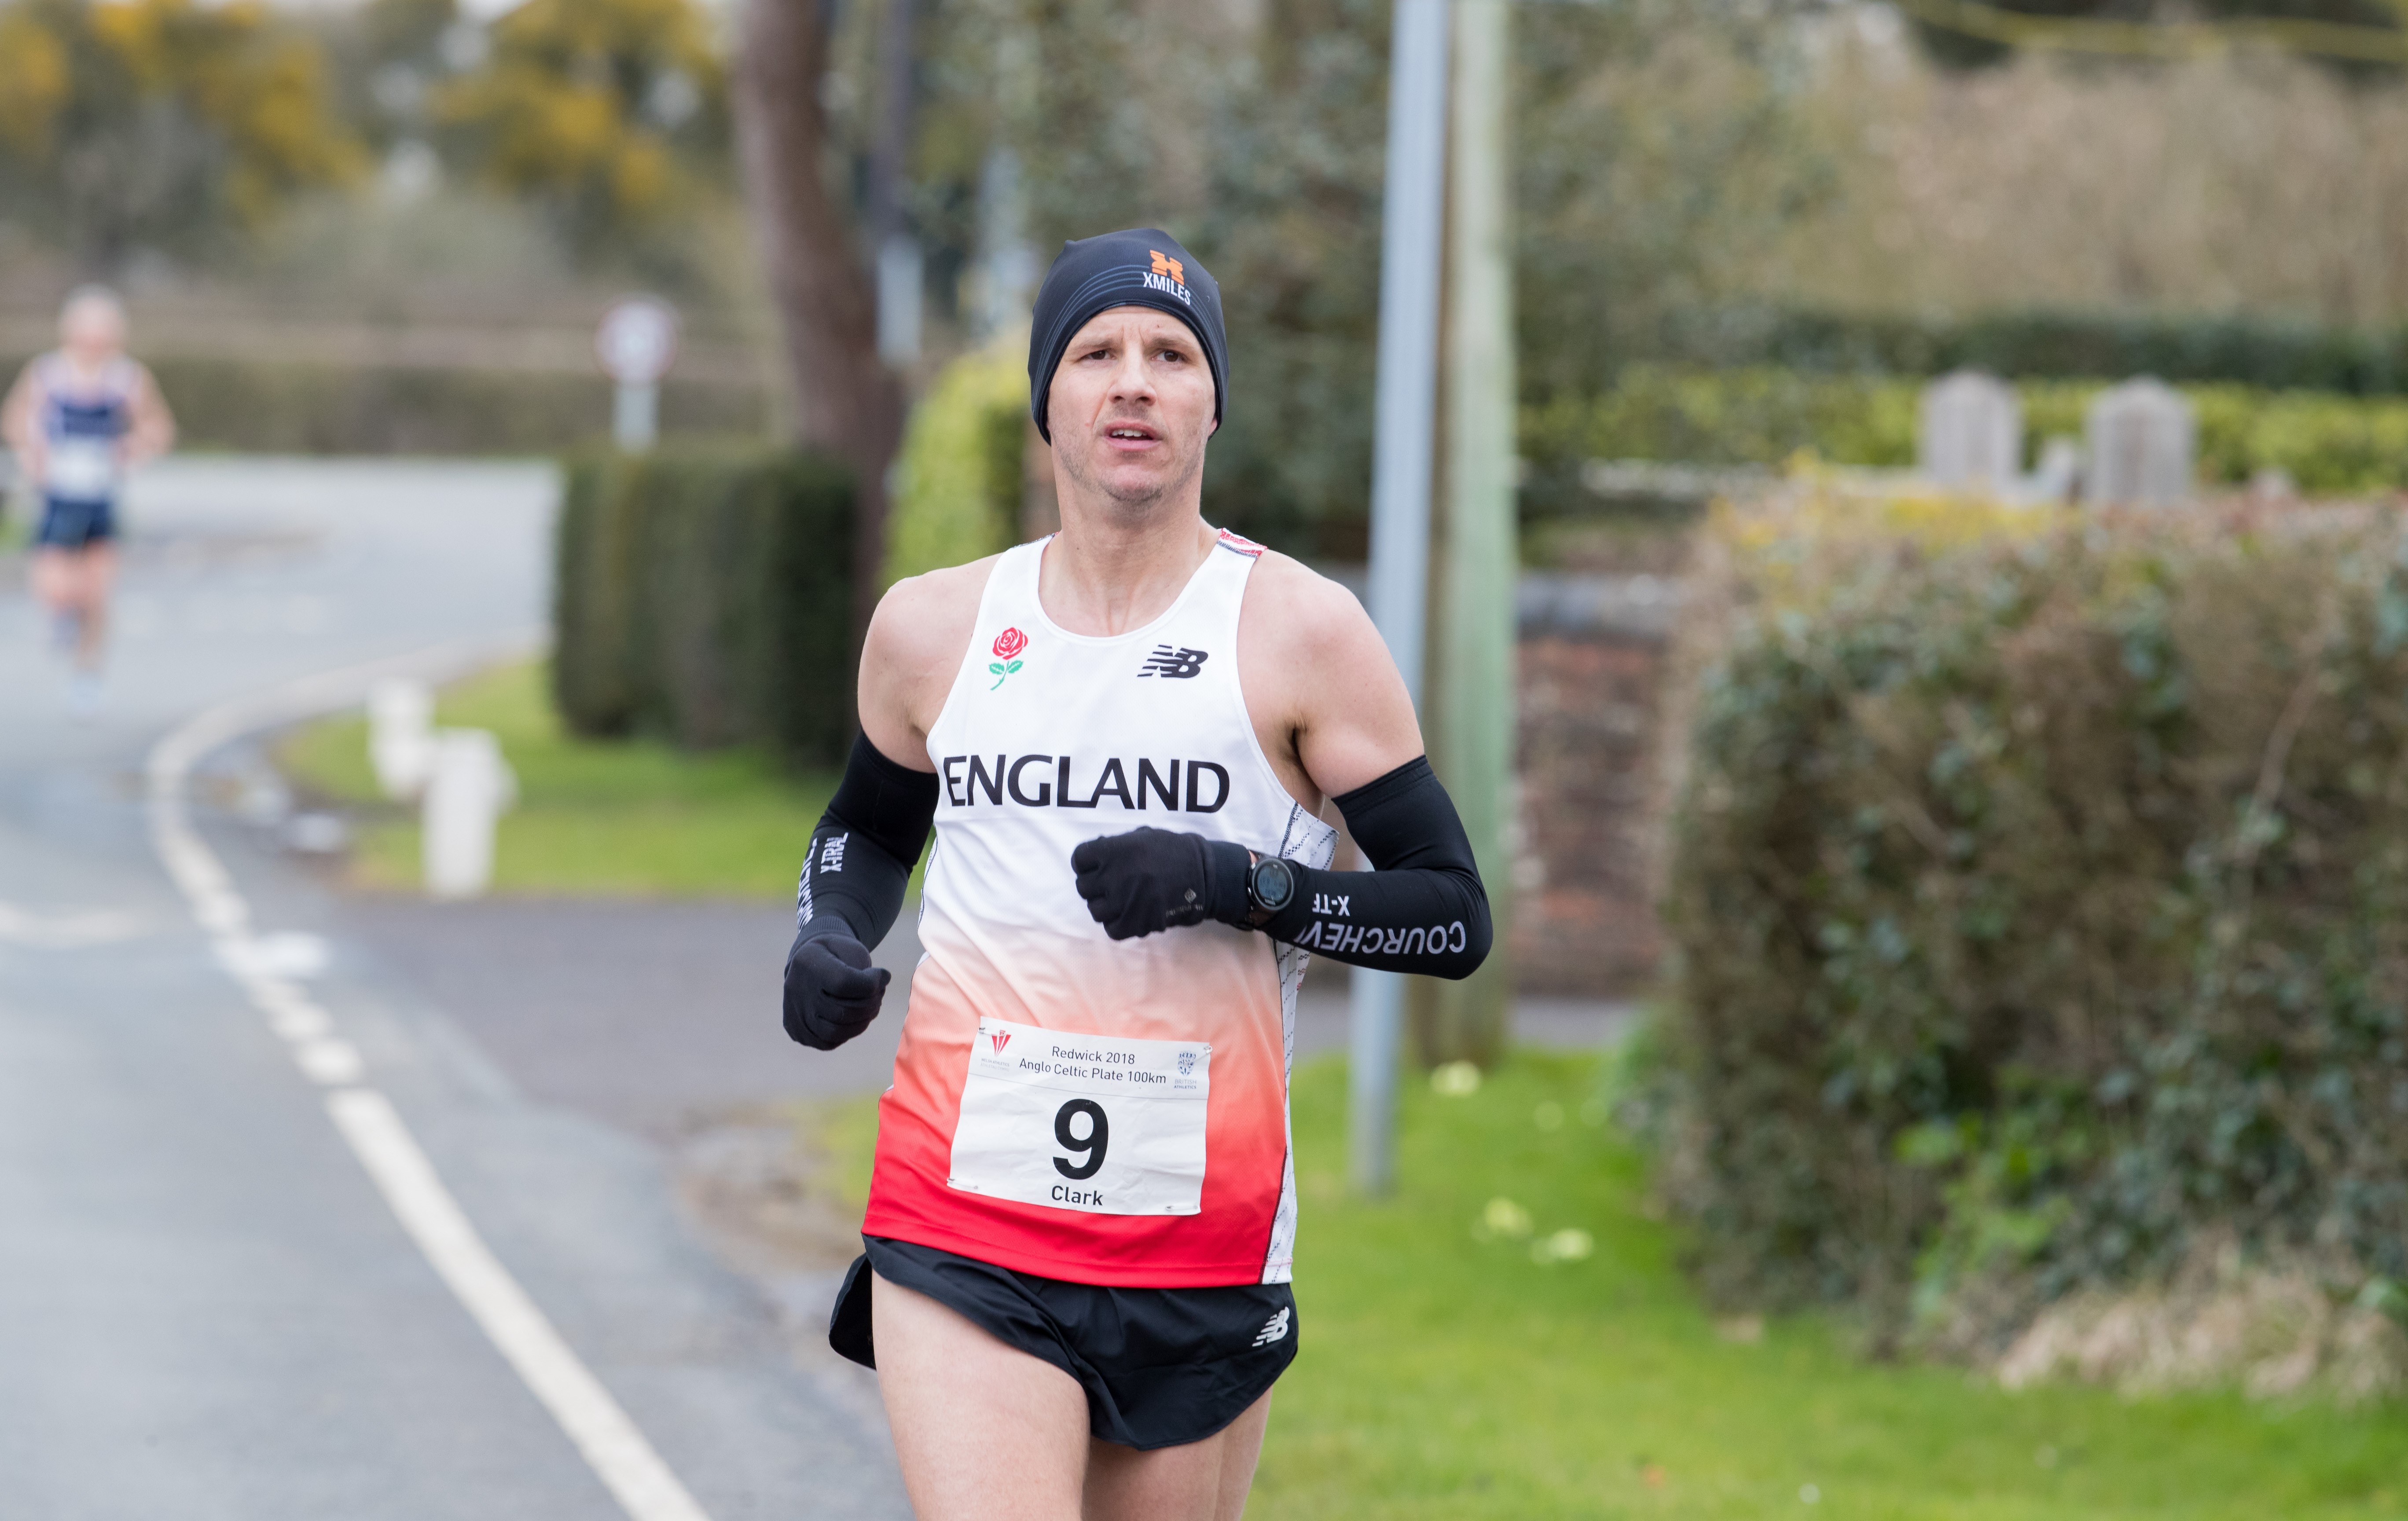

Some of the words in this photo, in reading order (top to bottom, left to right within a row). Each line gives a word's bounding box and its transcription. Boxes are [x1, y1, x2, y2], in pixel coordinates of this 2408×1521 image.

[1143, 272, 1191, 306] XMILES
[943, 754, 1230, 814] ENGLAND
[1293, 920, 1466, 954] COURCHEV
[1019, 1058, 1051, 1074] Anglo
[1054, 1064, 1087, 1078] Celtic
[1092, 1067, 1123, 1081] Plate
[1128, 1070, 1166, 1084] 100km
[1052, 1046, 1102, 1062] Redwick
[1106, 1052, 1135, 1065] 2018
[1053, 1099, 1109, 1180] 9
[1051, 1185, 1104, 1206] Clark
